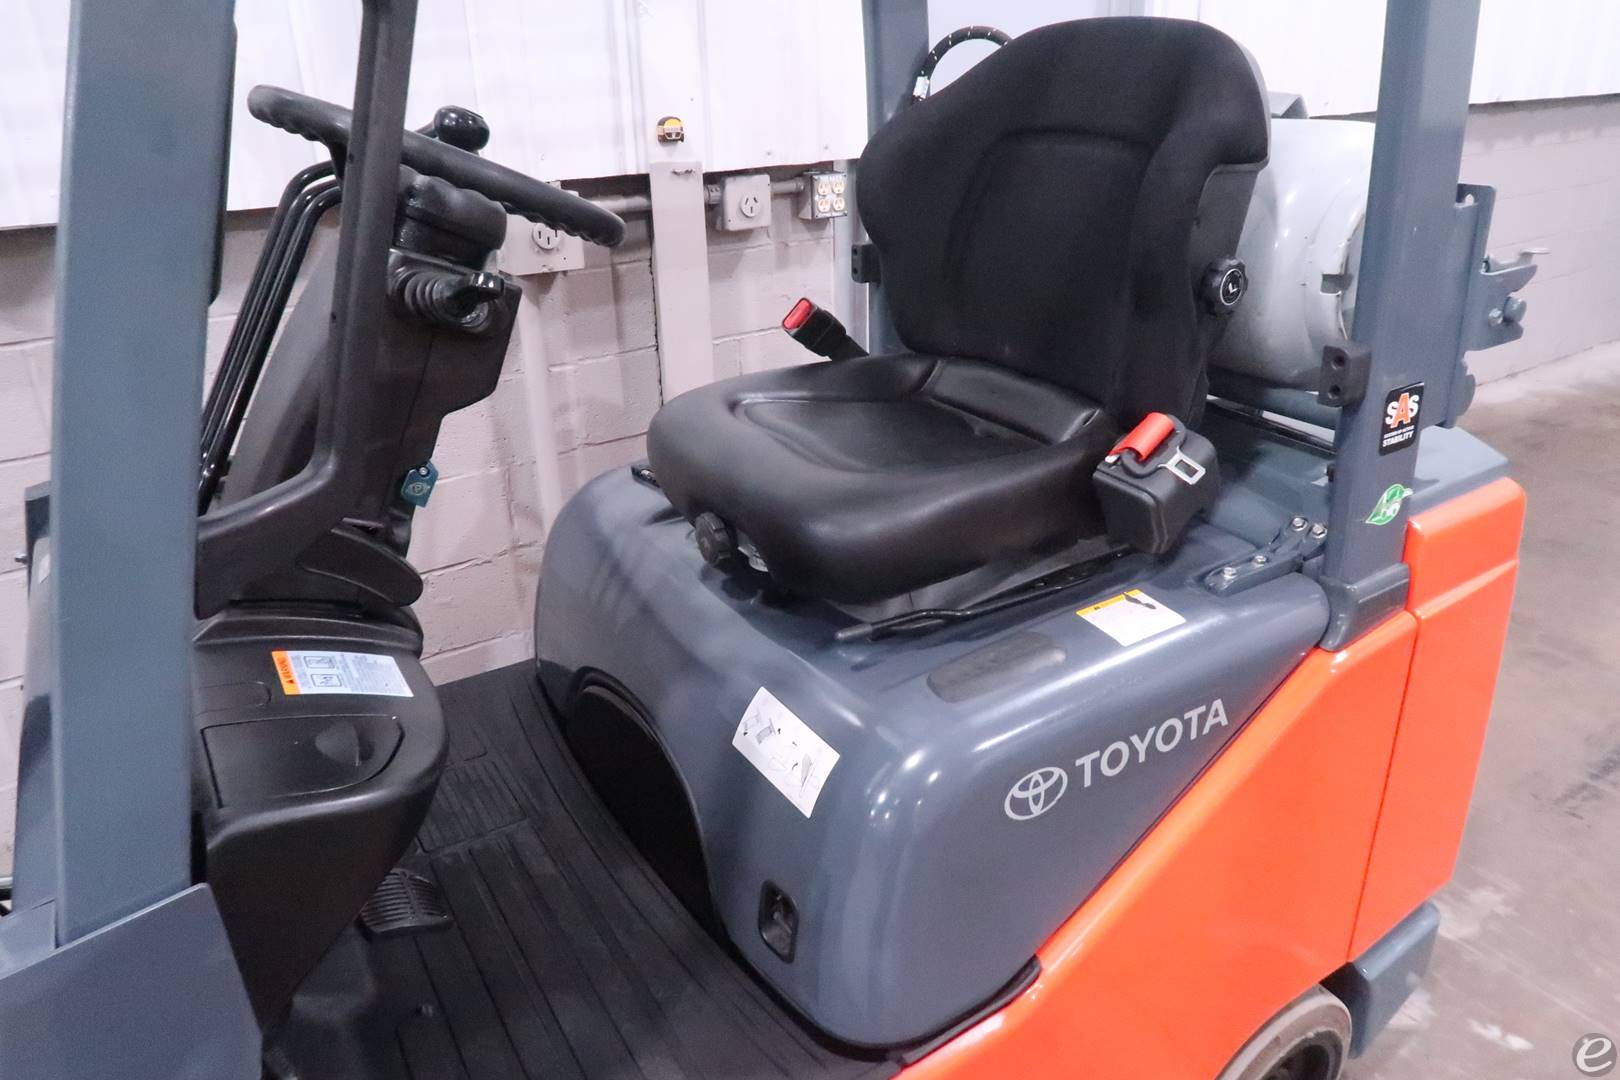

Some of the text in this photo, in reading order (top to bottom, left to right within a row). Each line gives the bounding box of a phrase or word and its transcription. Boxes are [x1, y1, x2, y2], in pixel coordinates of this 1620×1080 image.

[1385, 392, 1419, 428] SAS
[1383, 430, 1414, 447] STABILITY
[1075, 698, 1228, 788] TOYOTA
